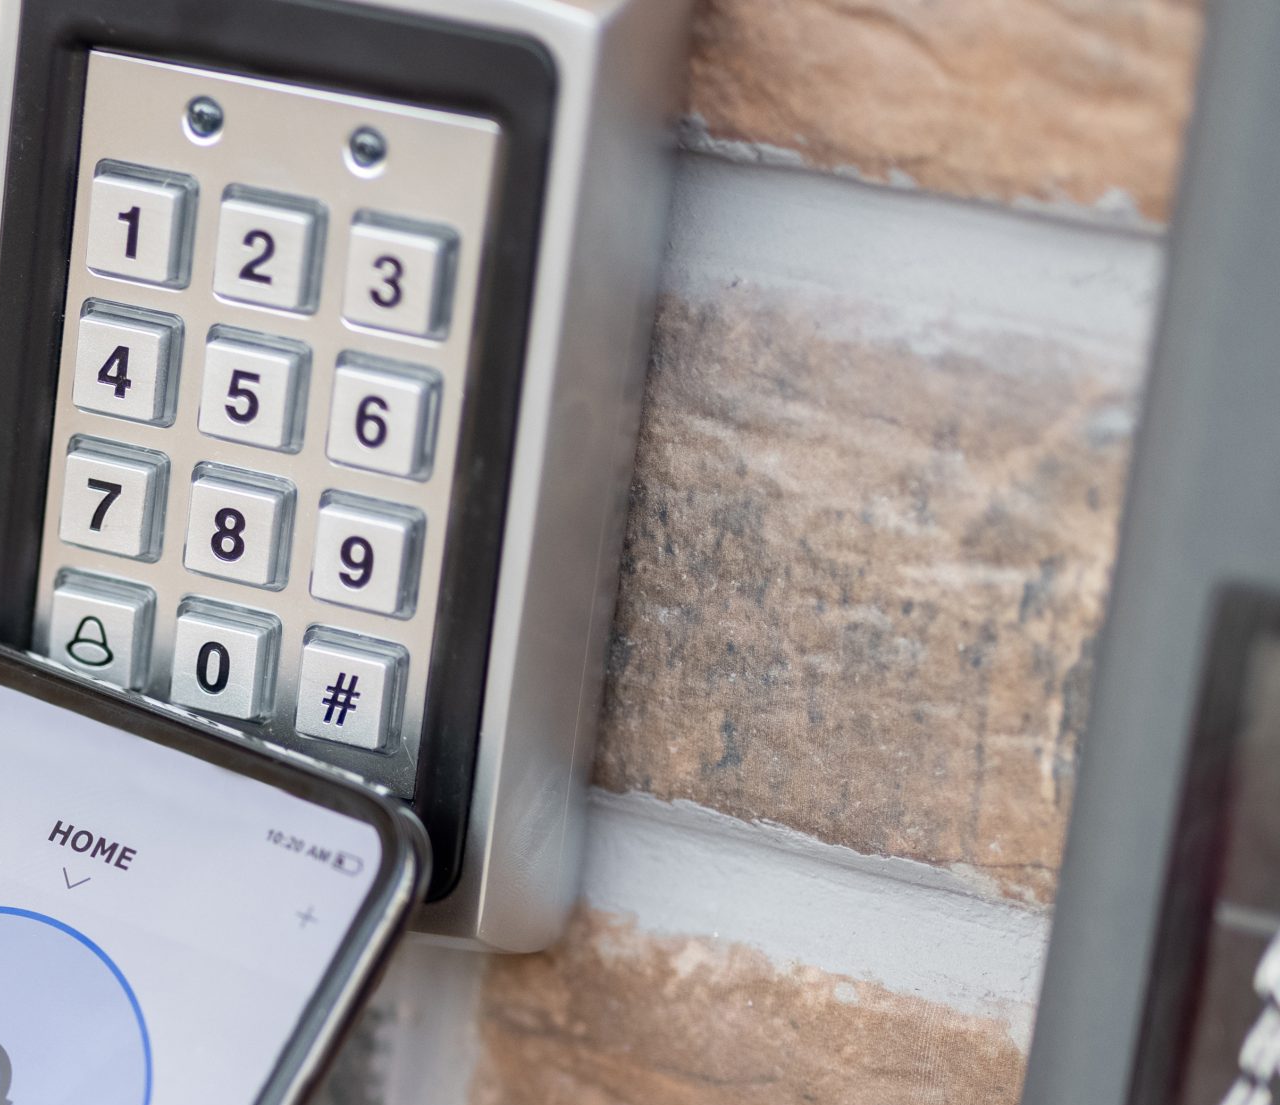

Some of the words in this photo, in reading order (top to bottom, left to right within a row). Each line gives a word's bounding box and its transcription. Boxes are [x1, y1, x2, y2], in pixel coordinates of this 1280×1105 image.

[118, 205, 141, 260] 1
[238, 229, 276, 285] 2
[369, 254, 404, 309] 3
[97, 345, 132, 399] 4
[224, 368, 261, 424] 5
[354, 394, 389, 449] 6
[87, 477, 123, 532] 7
[210, 507, 246, 562] 8
[338, 535, 375, 589] 9
[195, 641, 231, 695] 0
[321, 672, 361, 727] #
[47, 820, 137, 871] HOME
[306, 845, 332, 863] AM
